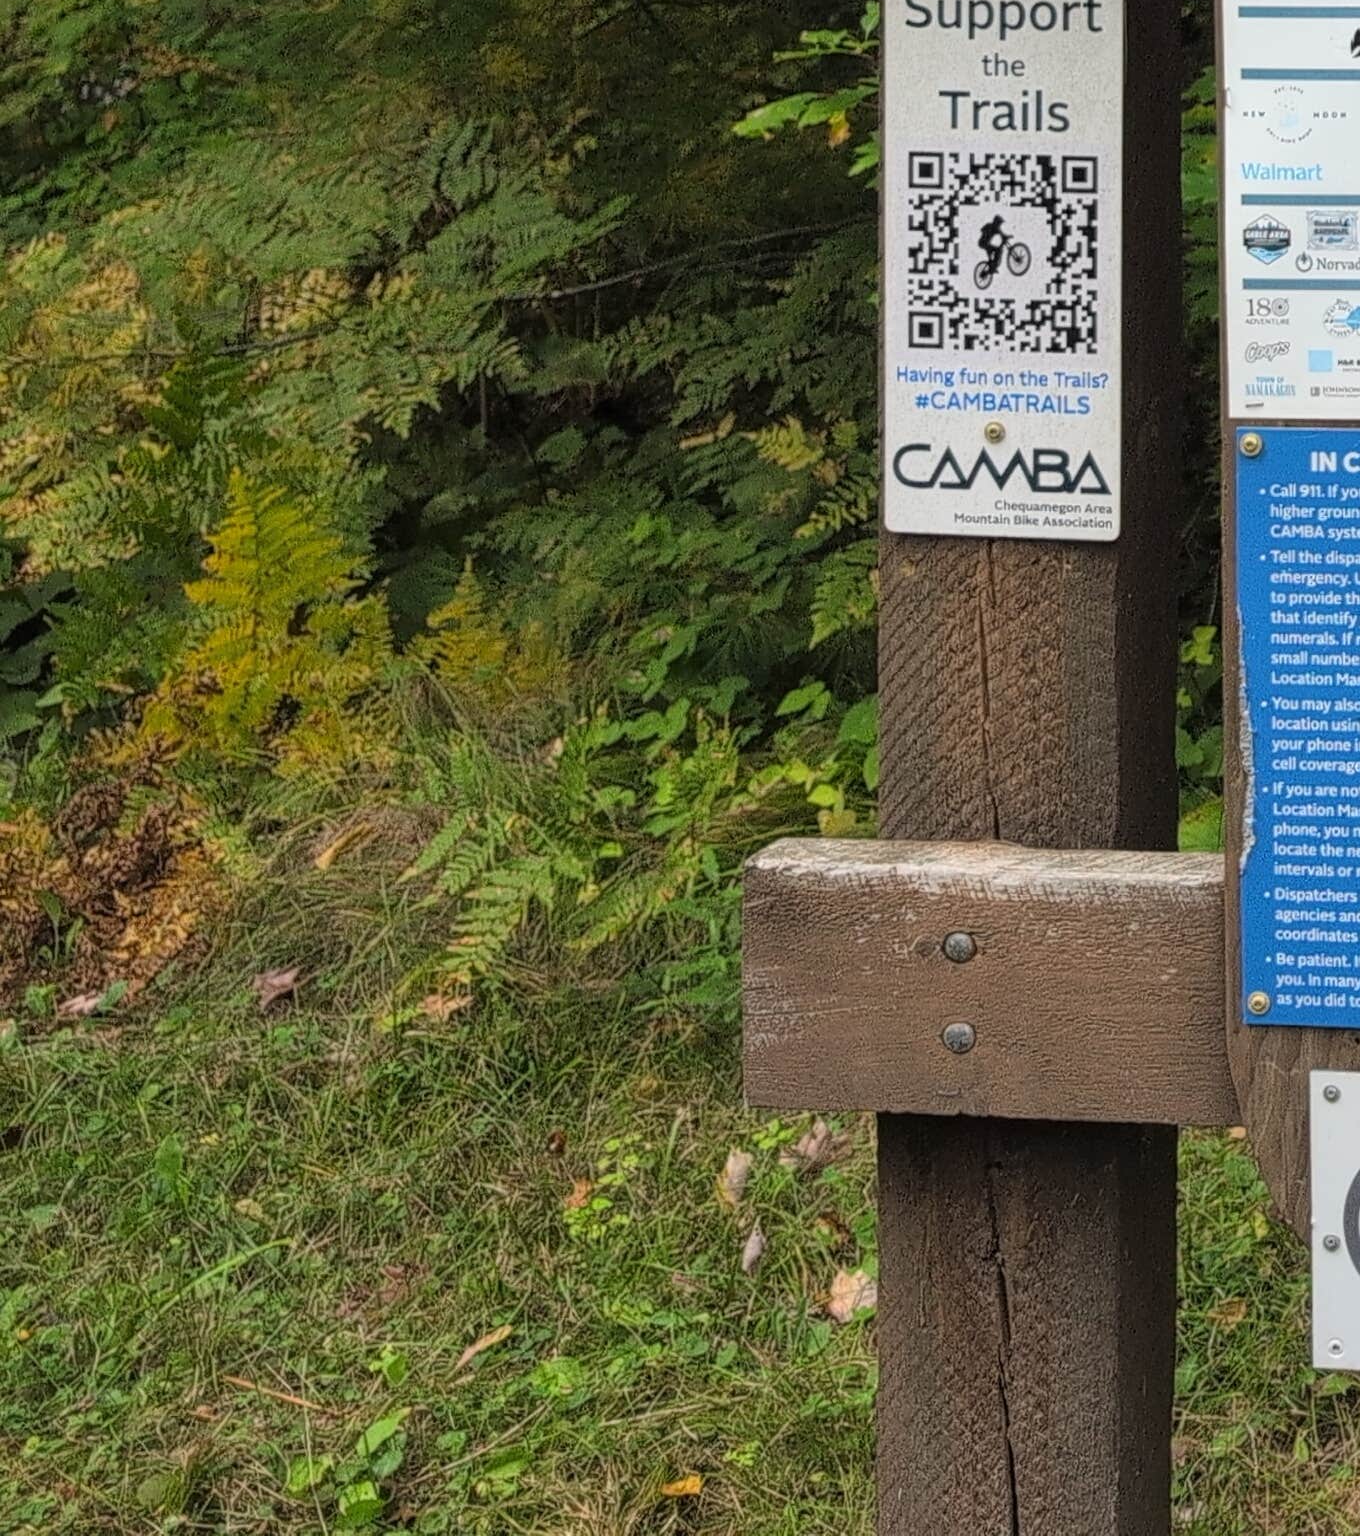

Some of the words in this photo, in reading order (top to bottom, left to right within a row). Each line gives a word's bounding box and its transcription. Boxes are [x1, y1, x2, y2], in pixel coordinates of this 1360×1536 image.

[982, 53, 1025, 77] the
[939, 90, 1069, 132] Trails
[1242, 163, 1322, 180] Walmart
[897, 366, 954, 388] Having
[960, 368, 987, 385] fun
[993, 372, 1014, 387] on
[1019, 370, 1048, 387] the
[1054, 371, 1108, 389] Trails?
[916, 391, 1090, 414] #CAMBATRAILS
[893, 443, 1111, 495] CAMBA
[1311, 452, 1336, 472] IN
[994, 500, 1081, 515] Chequamegon
[1084, 503, 1113, 514] Area
[954, 513, 1010, 525] Mountain
[1014, 514, 1038, 526] Bike
[1043, 516, 1112, 529] Association
[1272, 672, 1332, 685] Location
